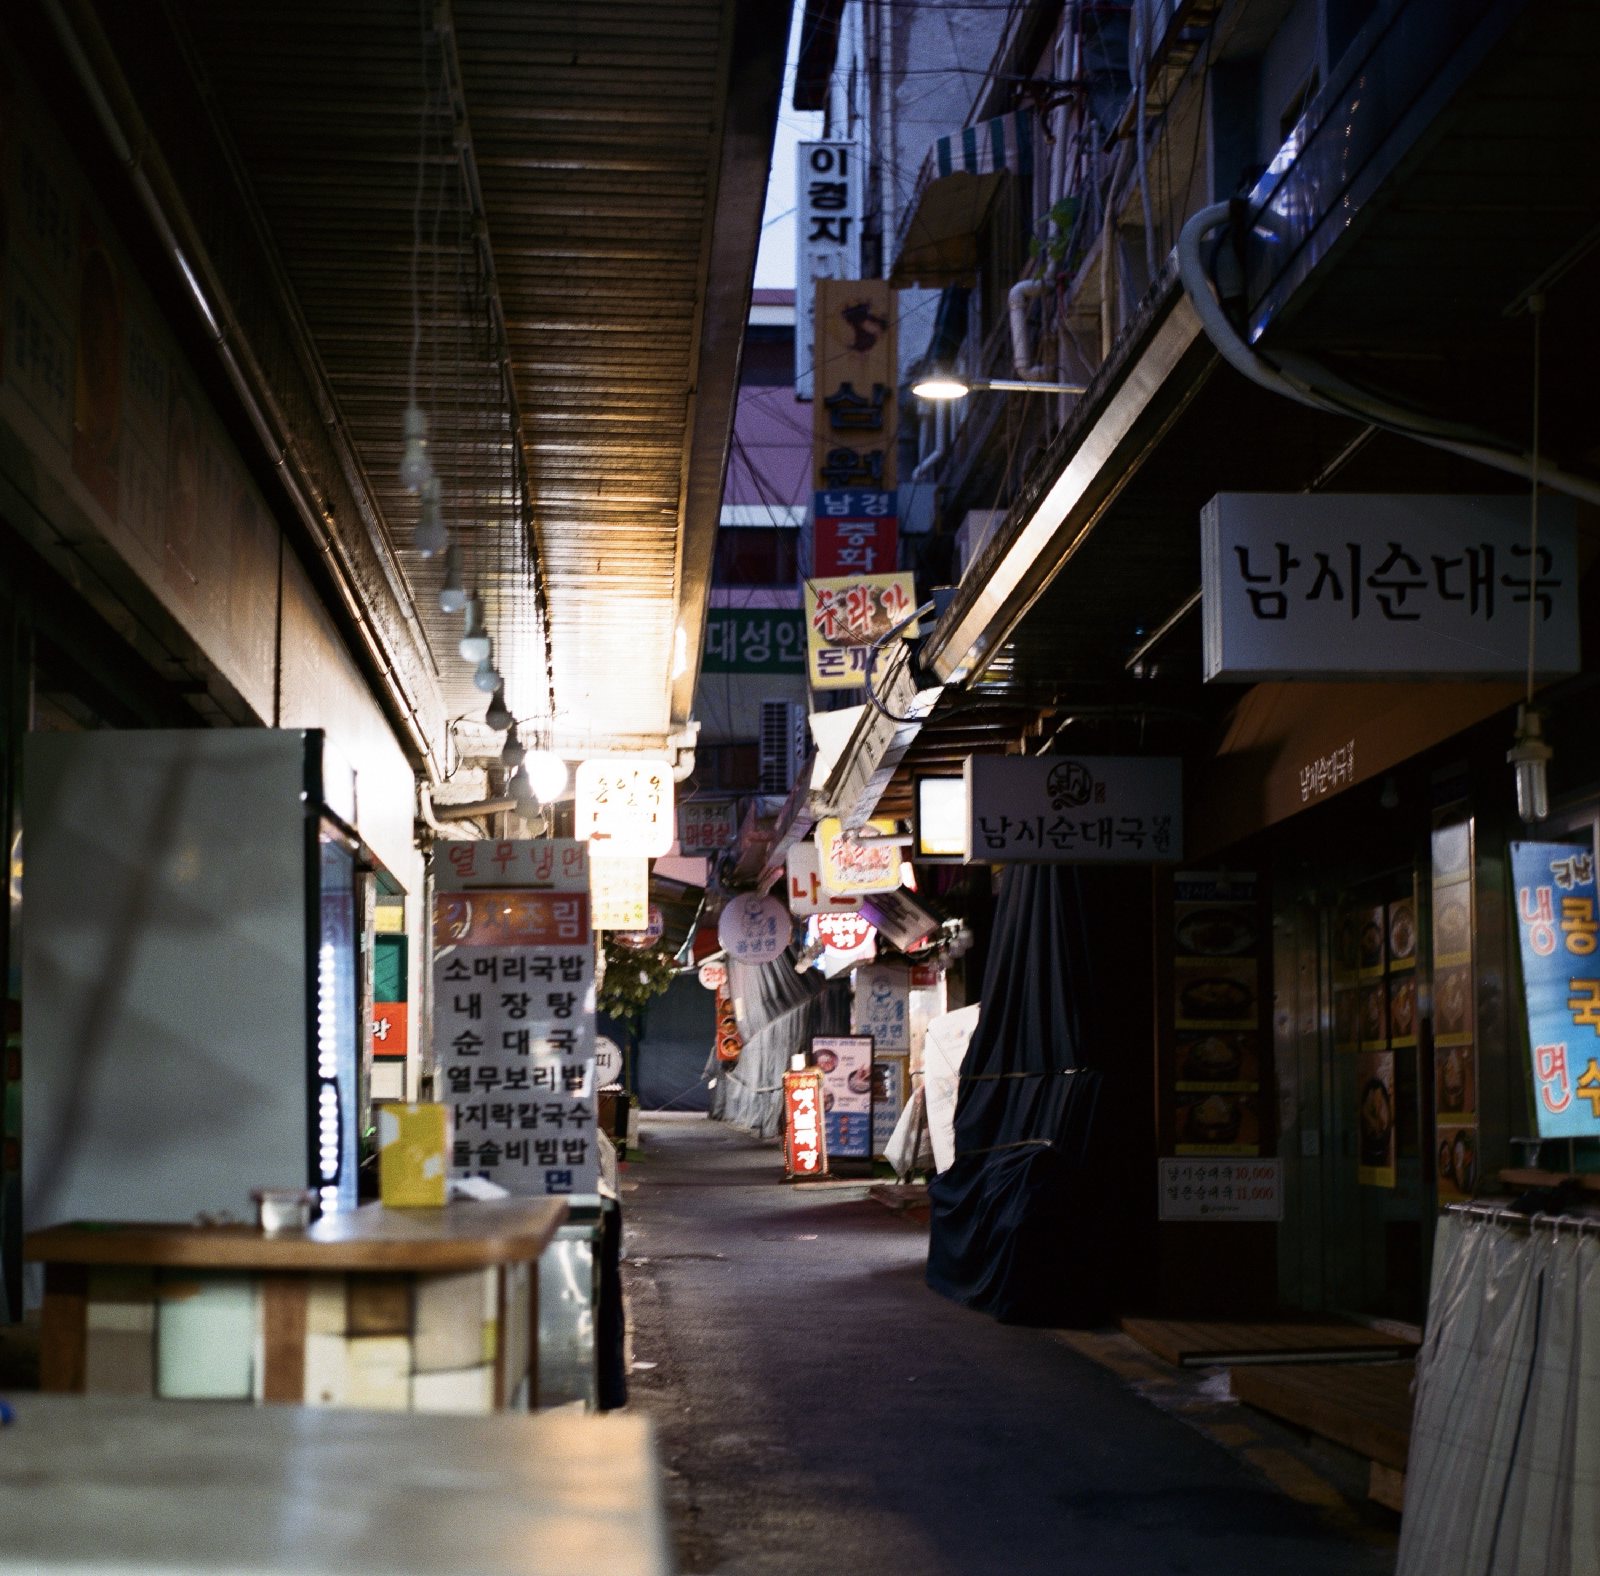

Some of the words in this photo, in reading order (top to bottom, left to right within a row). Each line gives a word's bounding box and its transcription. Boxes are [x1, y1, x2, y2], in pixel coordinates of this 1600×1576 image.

[808, 147, 853, 246] 이경자
[823, 492, 890, 516] 남경
[835, 521, 879, 577] 중화
[1234, 542, 1563, 622] 남시순대국
[816, 647, 891, 678] 돈까
[978, 815, 1148, 850] 남시순대국
[444, 956, 585, 983] 소머리국밥
[447, 1064, 586, 1094] 열무보리밥
[453, 1138, 588, 1168] 돌솥비빔밥
